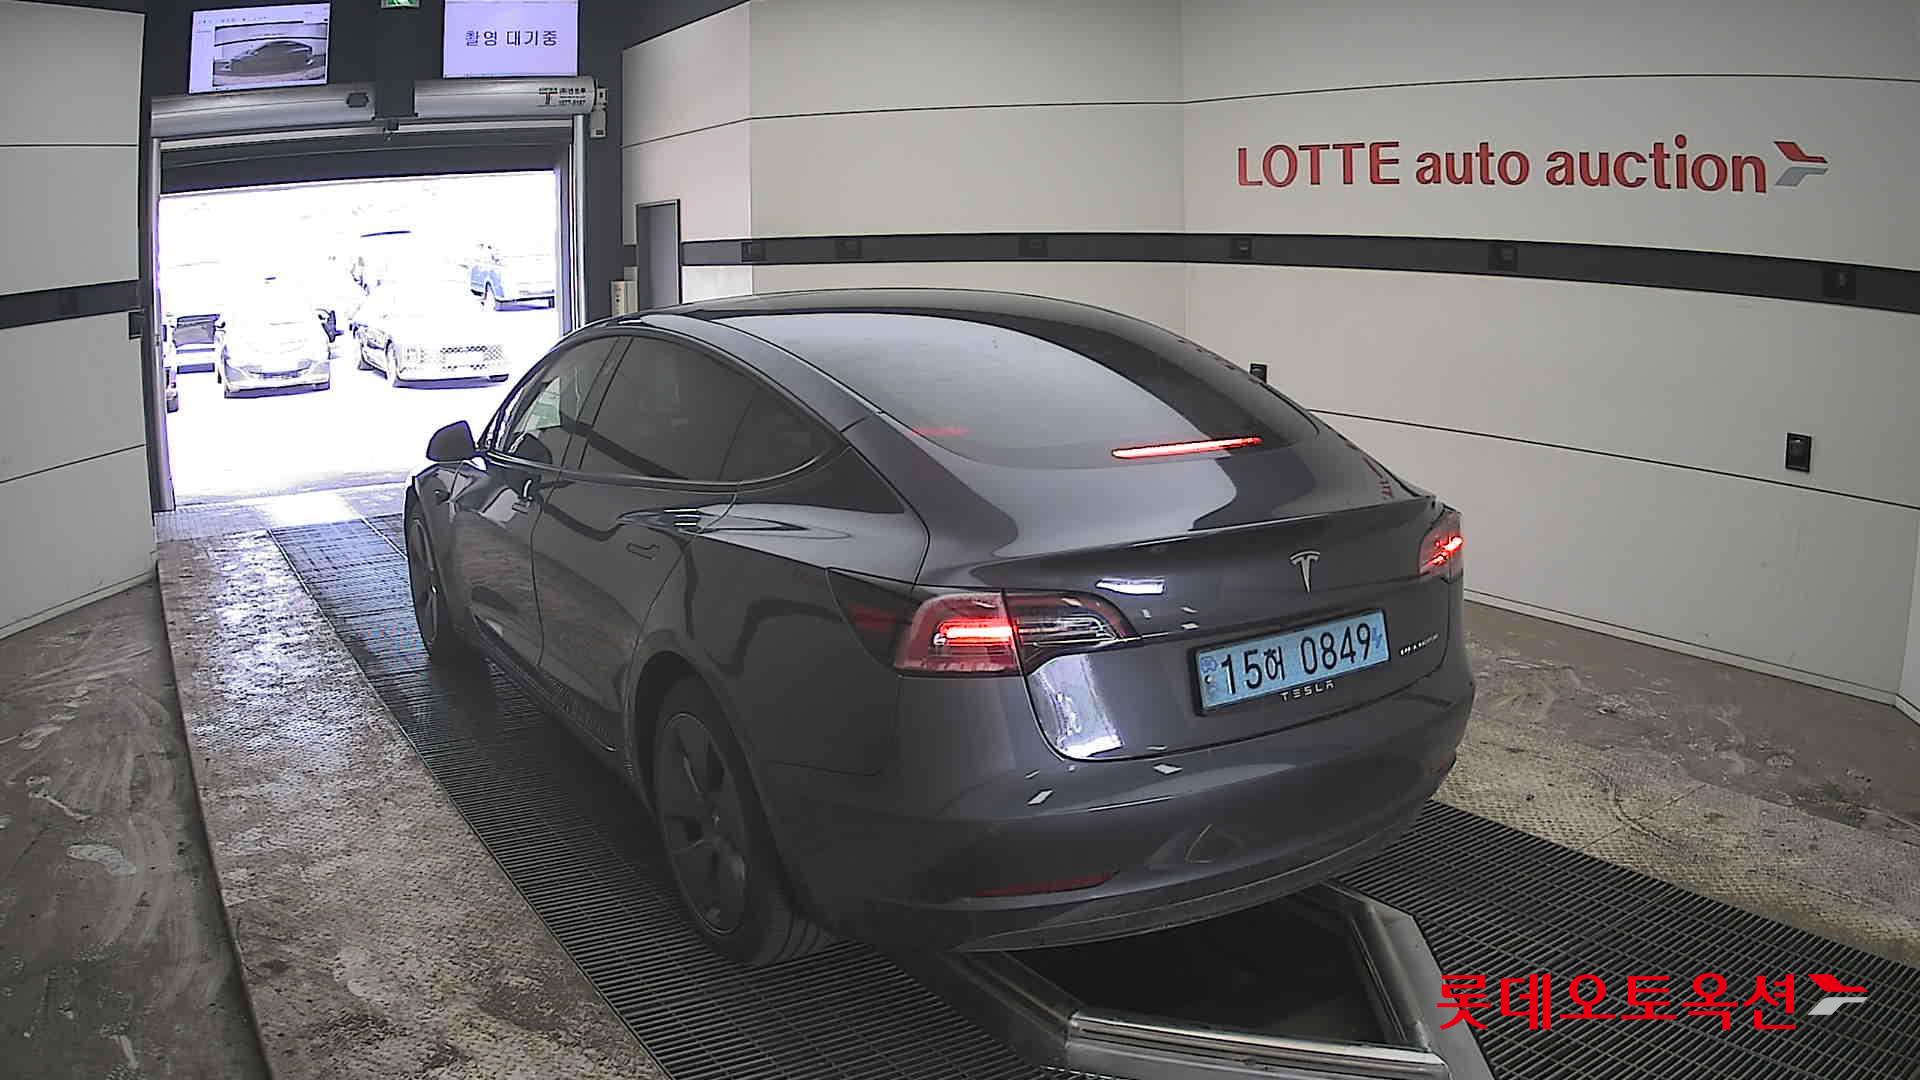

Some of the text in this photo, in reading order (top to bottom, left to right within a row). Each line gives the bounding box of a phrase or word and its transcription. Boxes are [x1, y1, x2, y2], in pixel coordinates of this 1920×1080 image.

[506, 30, 557, 47] 대기중
[1237, 134, 1767, 193] LOTTE auto auction
[1221, 645, 1285, 695] 15허
[1300, 623, 1372, 675] 0849
[1279, 680, 1335, 702] TESLA
